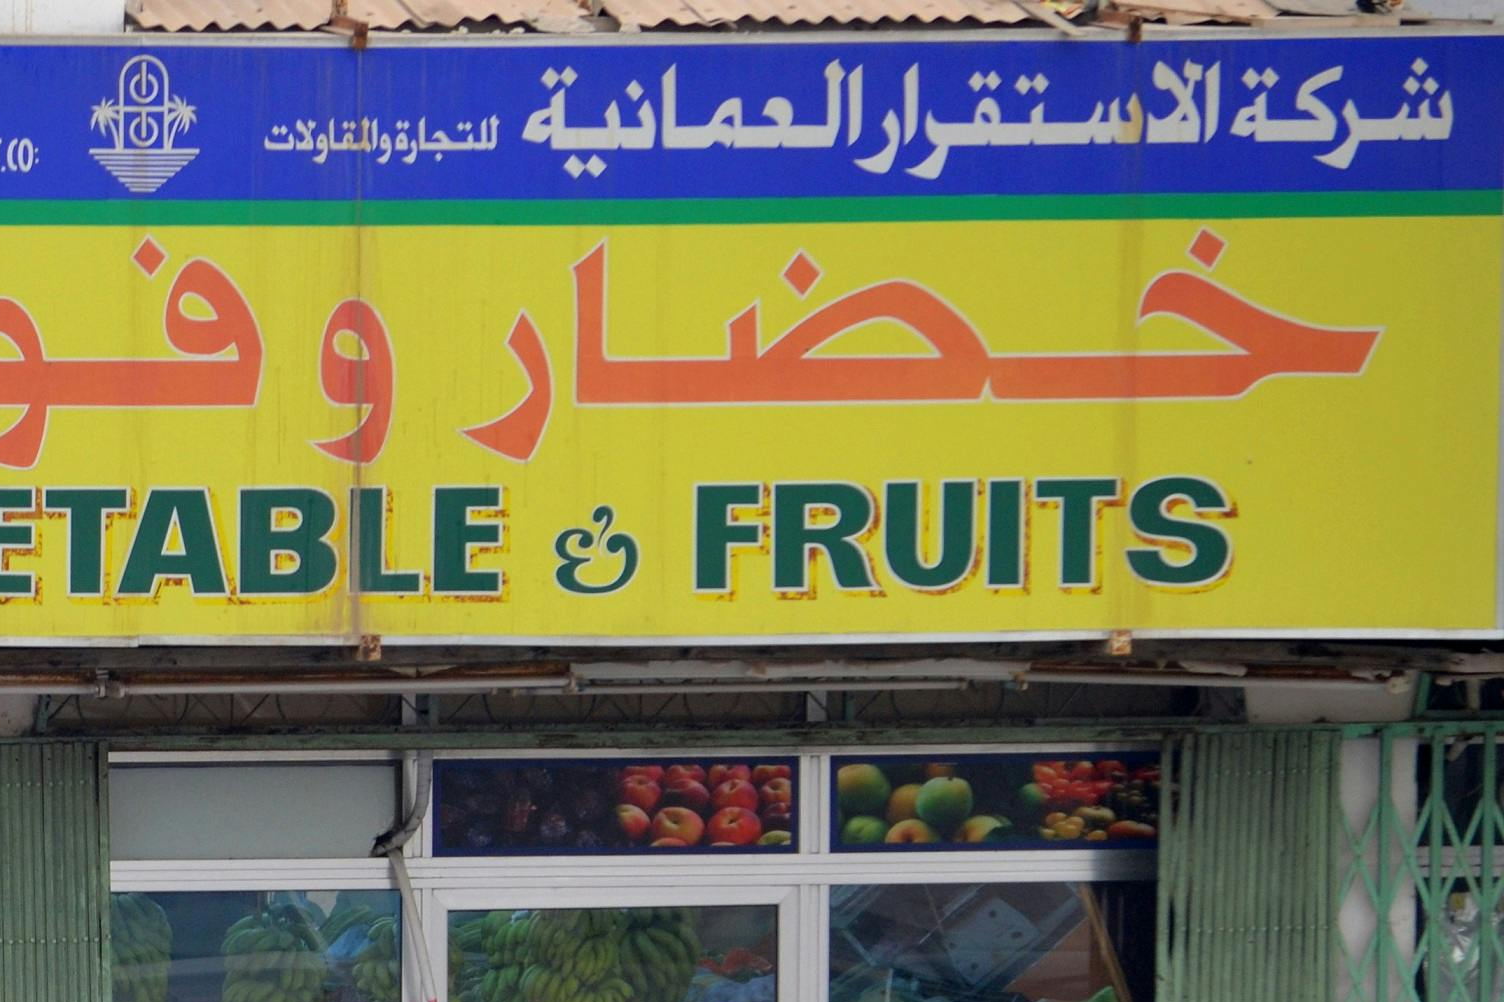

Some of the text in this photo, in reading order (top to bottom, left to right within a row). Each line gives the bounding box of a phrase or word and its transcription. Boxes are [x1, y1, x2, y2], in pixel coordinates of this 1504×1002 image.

[263, 58, 1454, 180] شركة الاستقرار العمانية للتجارة والمقاولات
[458, 226, 1387, 464] خضار
[553, 503, 640, 595] &
[693, 475, 1239, 600] FRUITS
